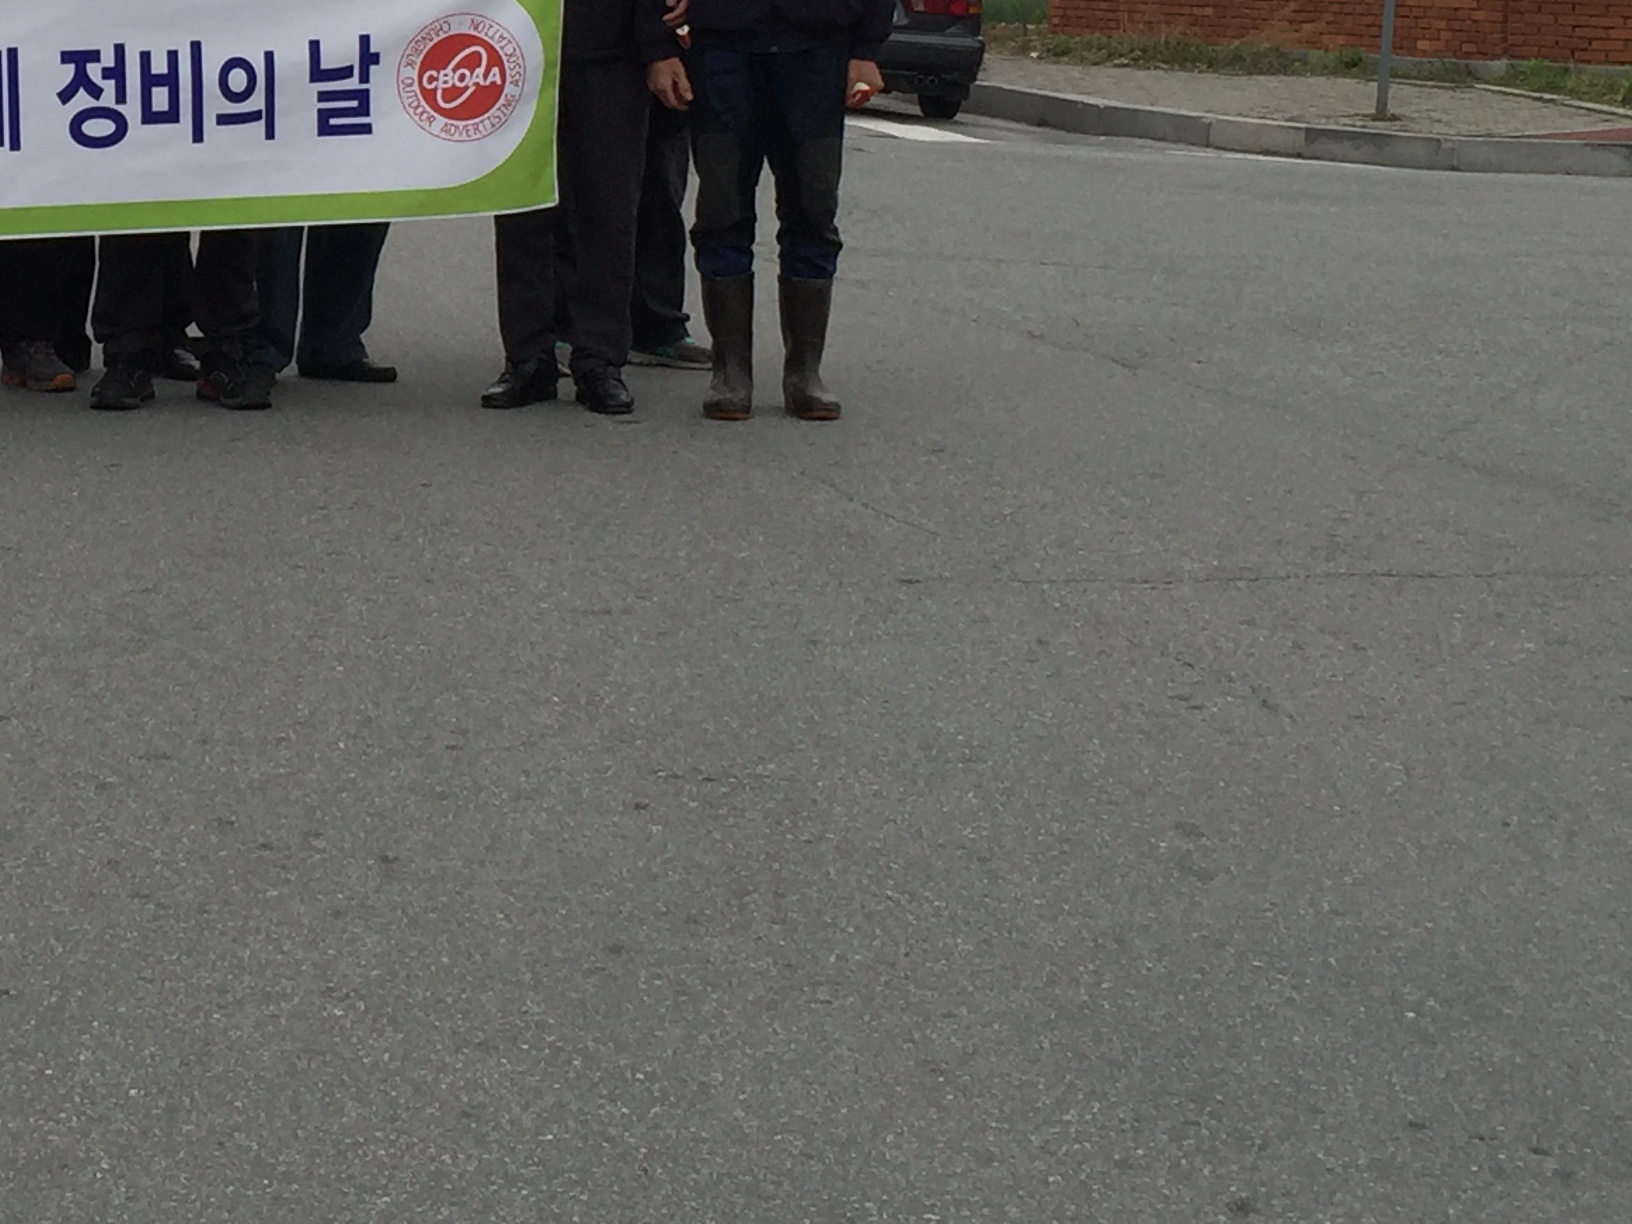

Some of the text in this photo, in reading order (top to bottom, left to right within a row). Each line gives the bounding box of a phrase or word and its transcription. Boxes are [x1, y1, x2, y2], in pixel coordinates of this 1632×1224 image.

[422, 66, 502, 90] CBOAA
[468, 18, 523, 88] ASSOCIATION
[56, 40, 276, 149] 정비의
[308, 34, 381, 137] 날
[401, 77, 436, 129] OUTDOOR
[440, 93, 516, 138] ADVERTISING
